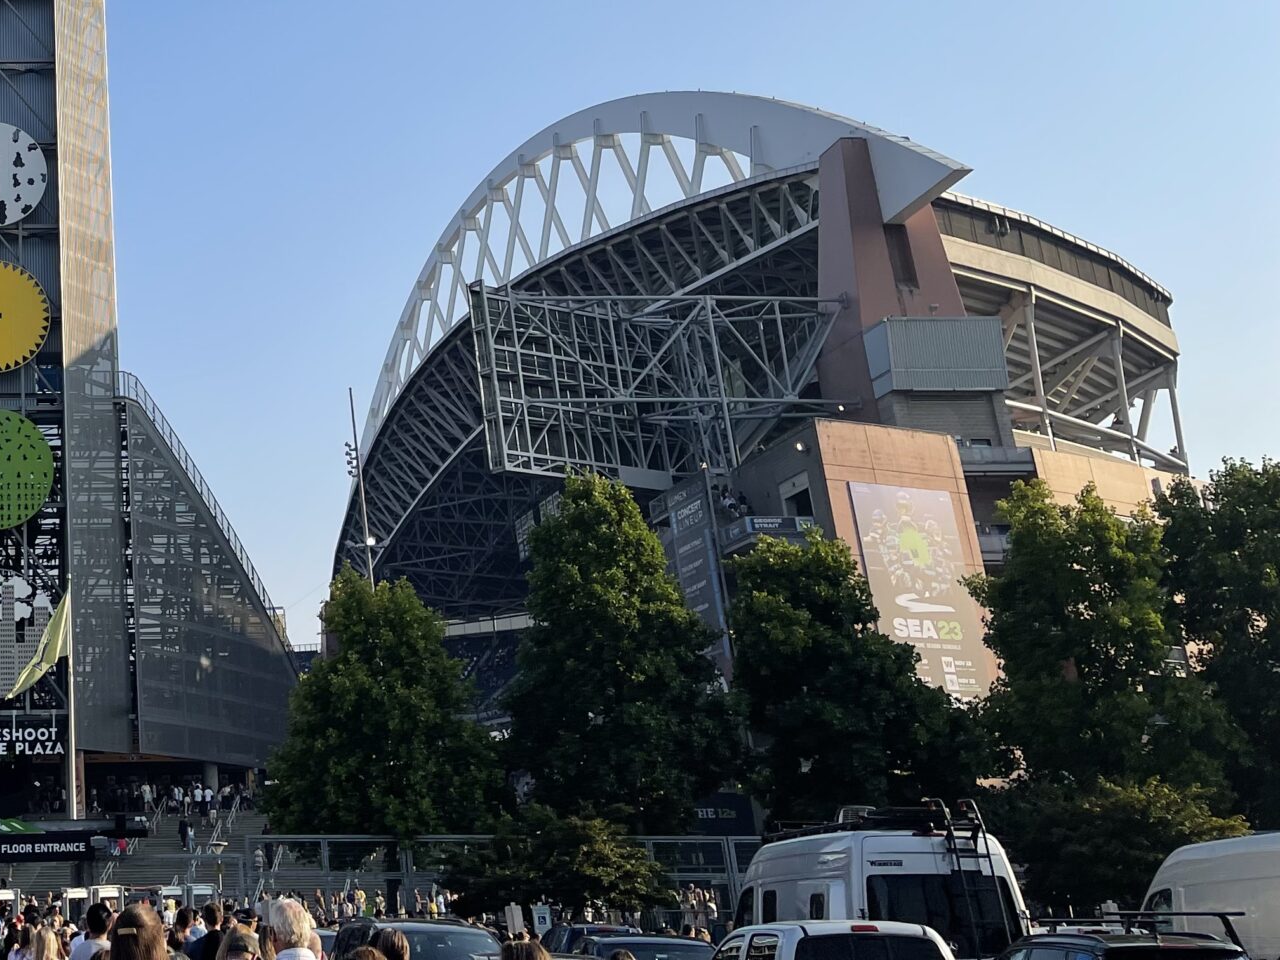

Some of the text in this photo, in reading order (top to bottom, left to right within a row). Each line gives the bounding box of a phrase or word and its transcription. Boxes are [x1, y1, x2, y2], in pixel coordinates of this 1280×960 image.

[677, 499, 702, 520] CONCERT
[15, 741, 65, 755] PLAZA
[1, 843, 86, 853] FLOOR ENTRANCE
